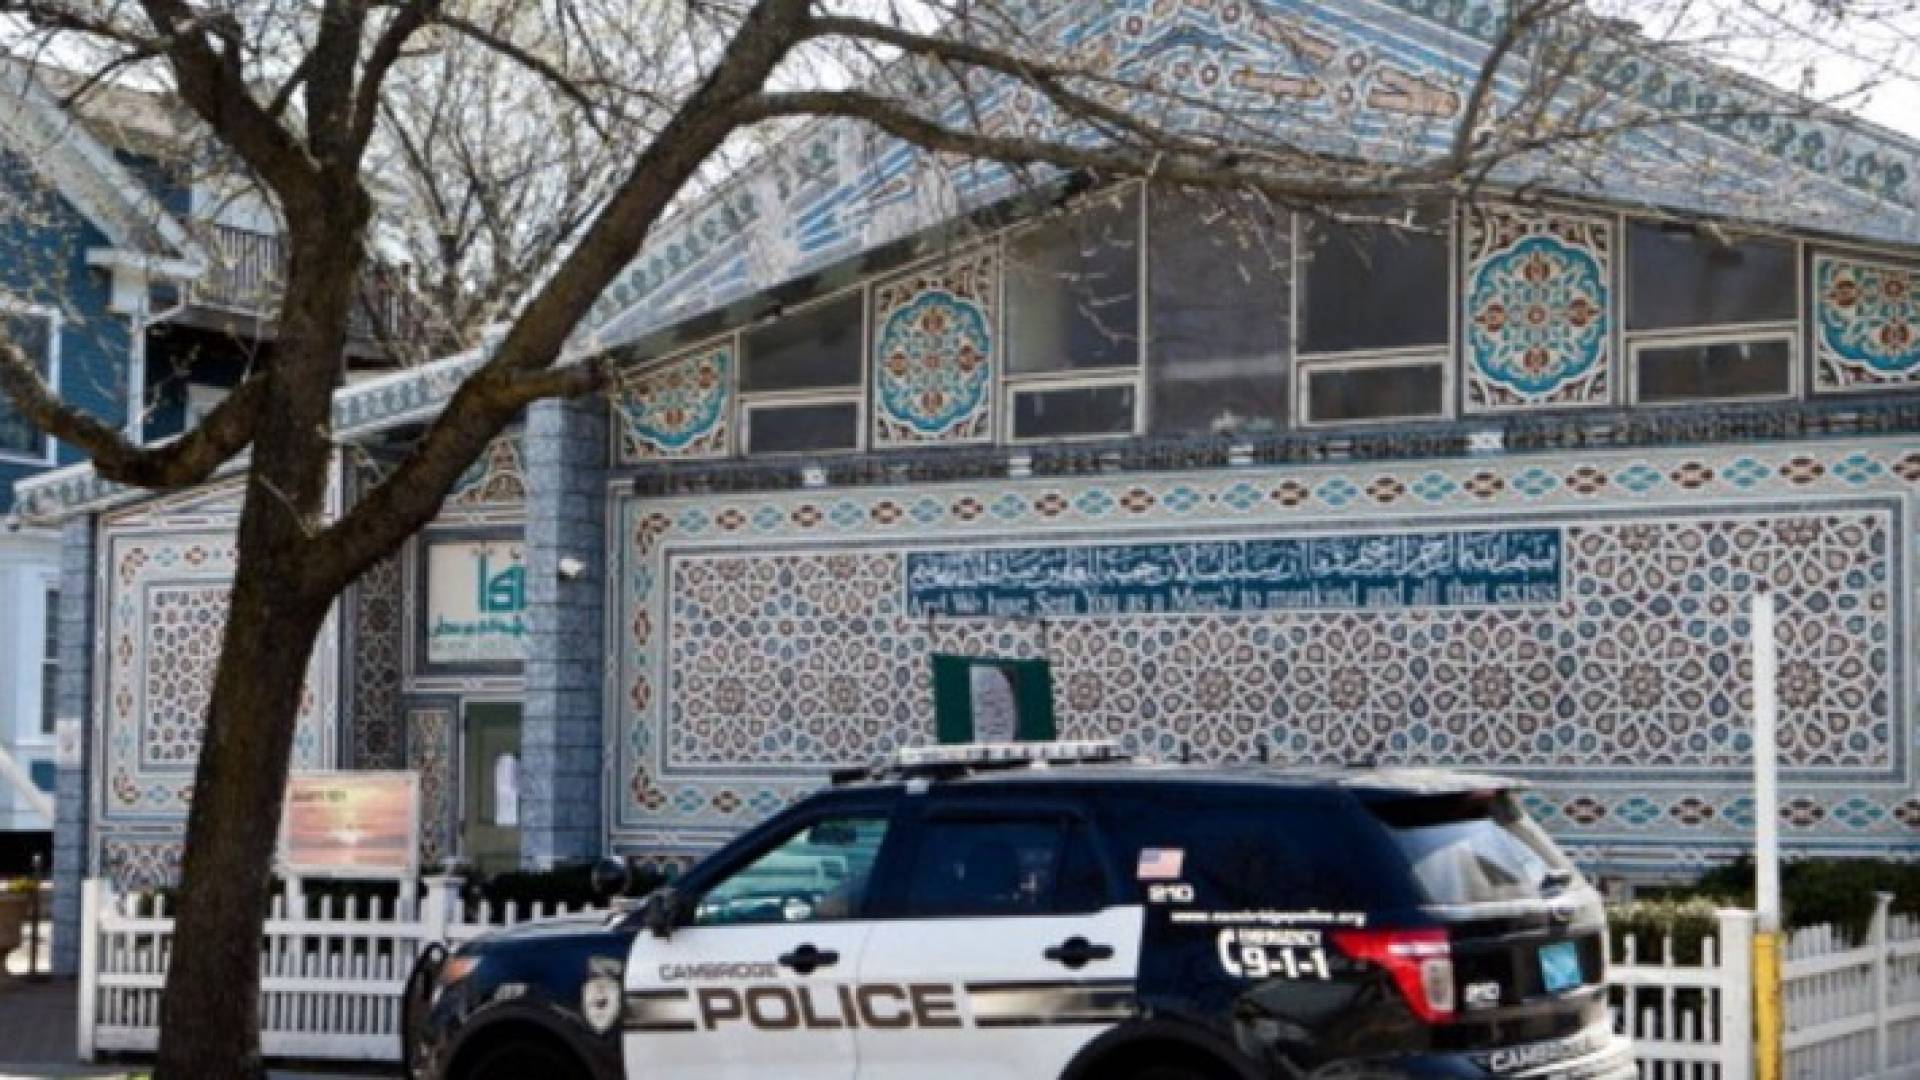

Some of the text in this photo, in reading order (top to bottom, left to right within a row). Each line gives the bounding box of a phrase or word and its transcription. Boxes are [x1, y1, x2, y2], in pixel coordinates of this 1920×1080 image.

[658, 964, 778, 980] CAMBRIDGE
[1241, 945, 1330, 978] 9-1-1
[698, 984, 962, 1031] POLICE
